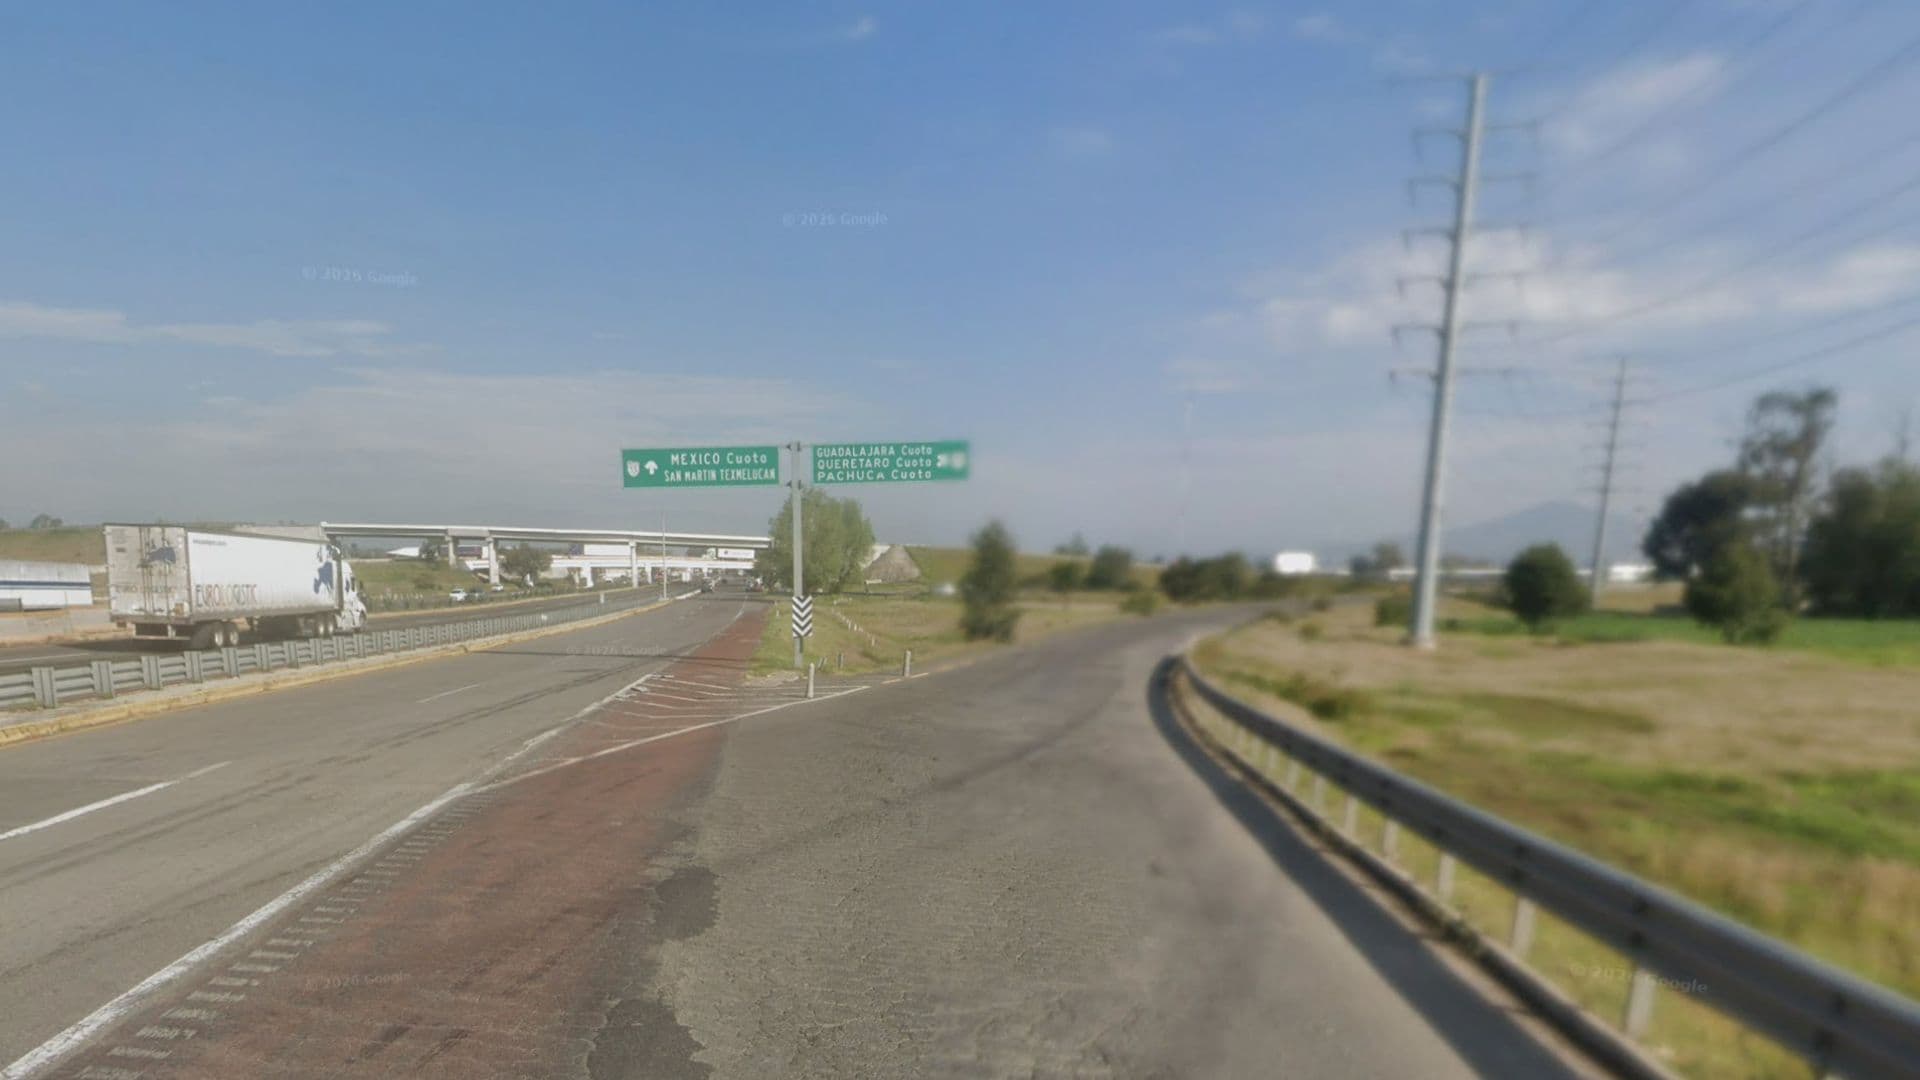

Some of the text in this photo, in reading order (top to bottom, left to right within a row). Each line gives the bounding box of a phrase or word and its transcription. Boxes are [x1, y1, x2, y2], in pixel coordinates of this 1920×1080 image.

[817, 446, 895, 458] GUADALAJARA
[671, 453, 720, 465] MEXICO
[817, 458, 890, 470] QUERETARO
[664, 468, 775, 482] SAN MARTIN TEXMELUCAN
[817, 470, 885, 481] PACHUCA
